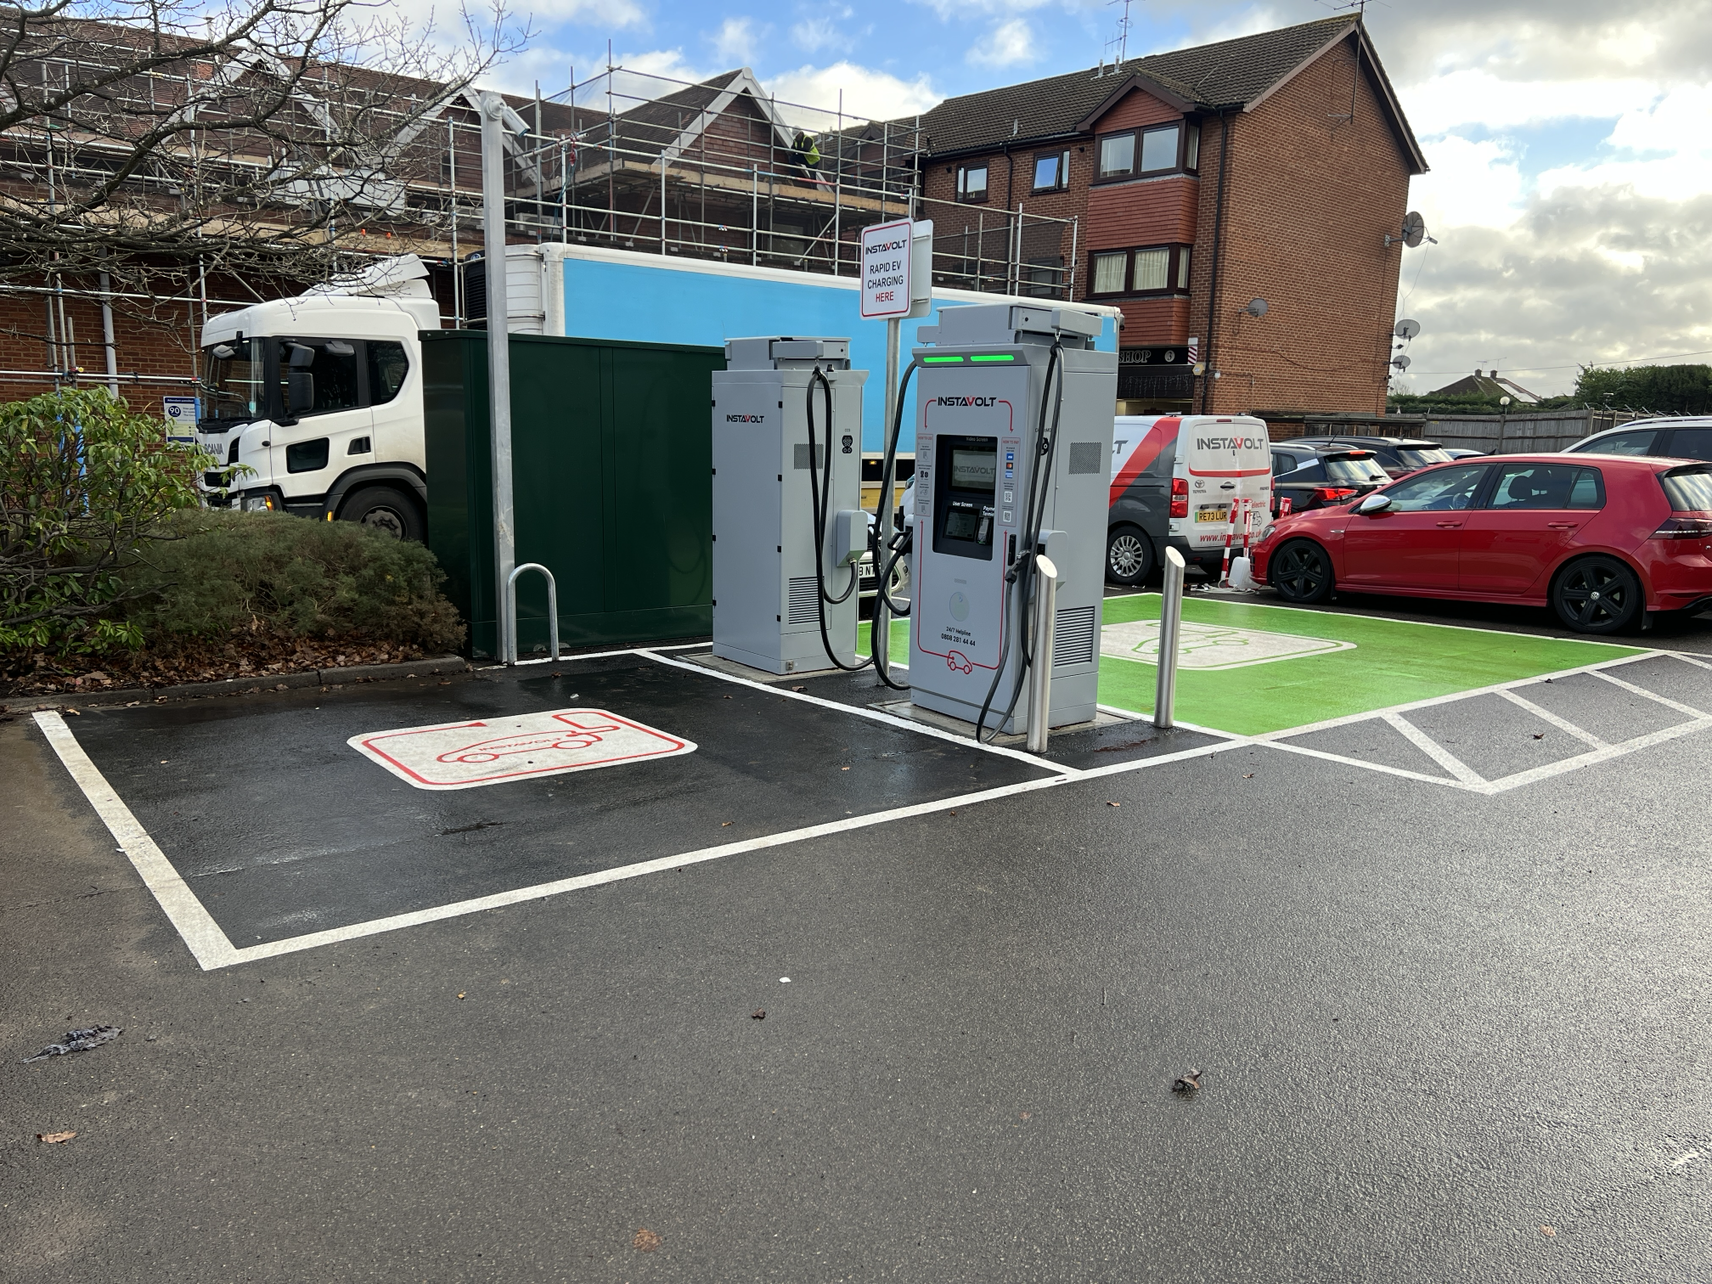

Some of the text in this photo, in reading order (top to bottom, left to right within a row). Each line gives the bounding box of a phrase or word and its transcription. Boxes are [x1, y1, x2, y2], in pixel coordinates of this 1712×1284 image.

[865, 239, 907, 255] INSTAVOLT
[869, 260, 902, 274] RAPID EV
[867, 275, 904, 289] CHARGING
[875, 291, 894, 302] HERE
[1119, 350, 1152, 363] SHOP
[937, 395, 997, 407] INSTAVOLT
[726, 414, 765, 423] INSTAVOLT
[1196, 436, 1264, 450] INSTAVOLT
[953, 465, 995, 475] INSTAVOLT
[1199, 512, 1215, 520] RE73
[955, 628, 971, 637] Helpline
